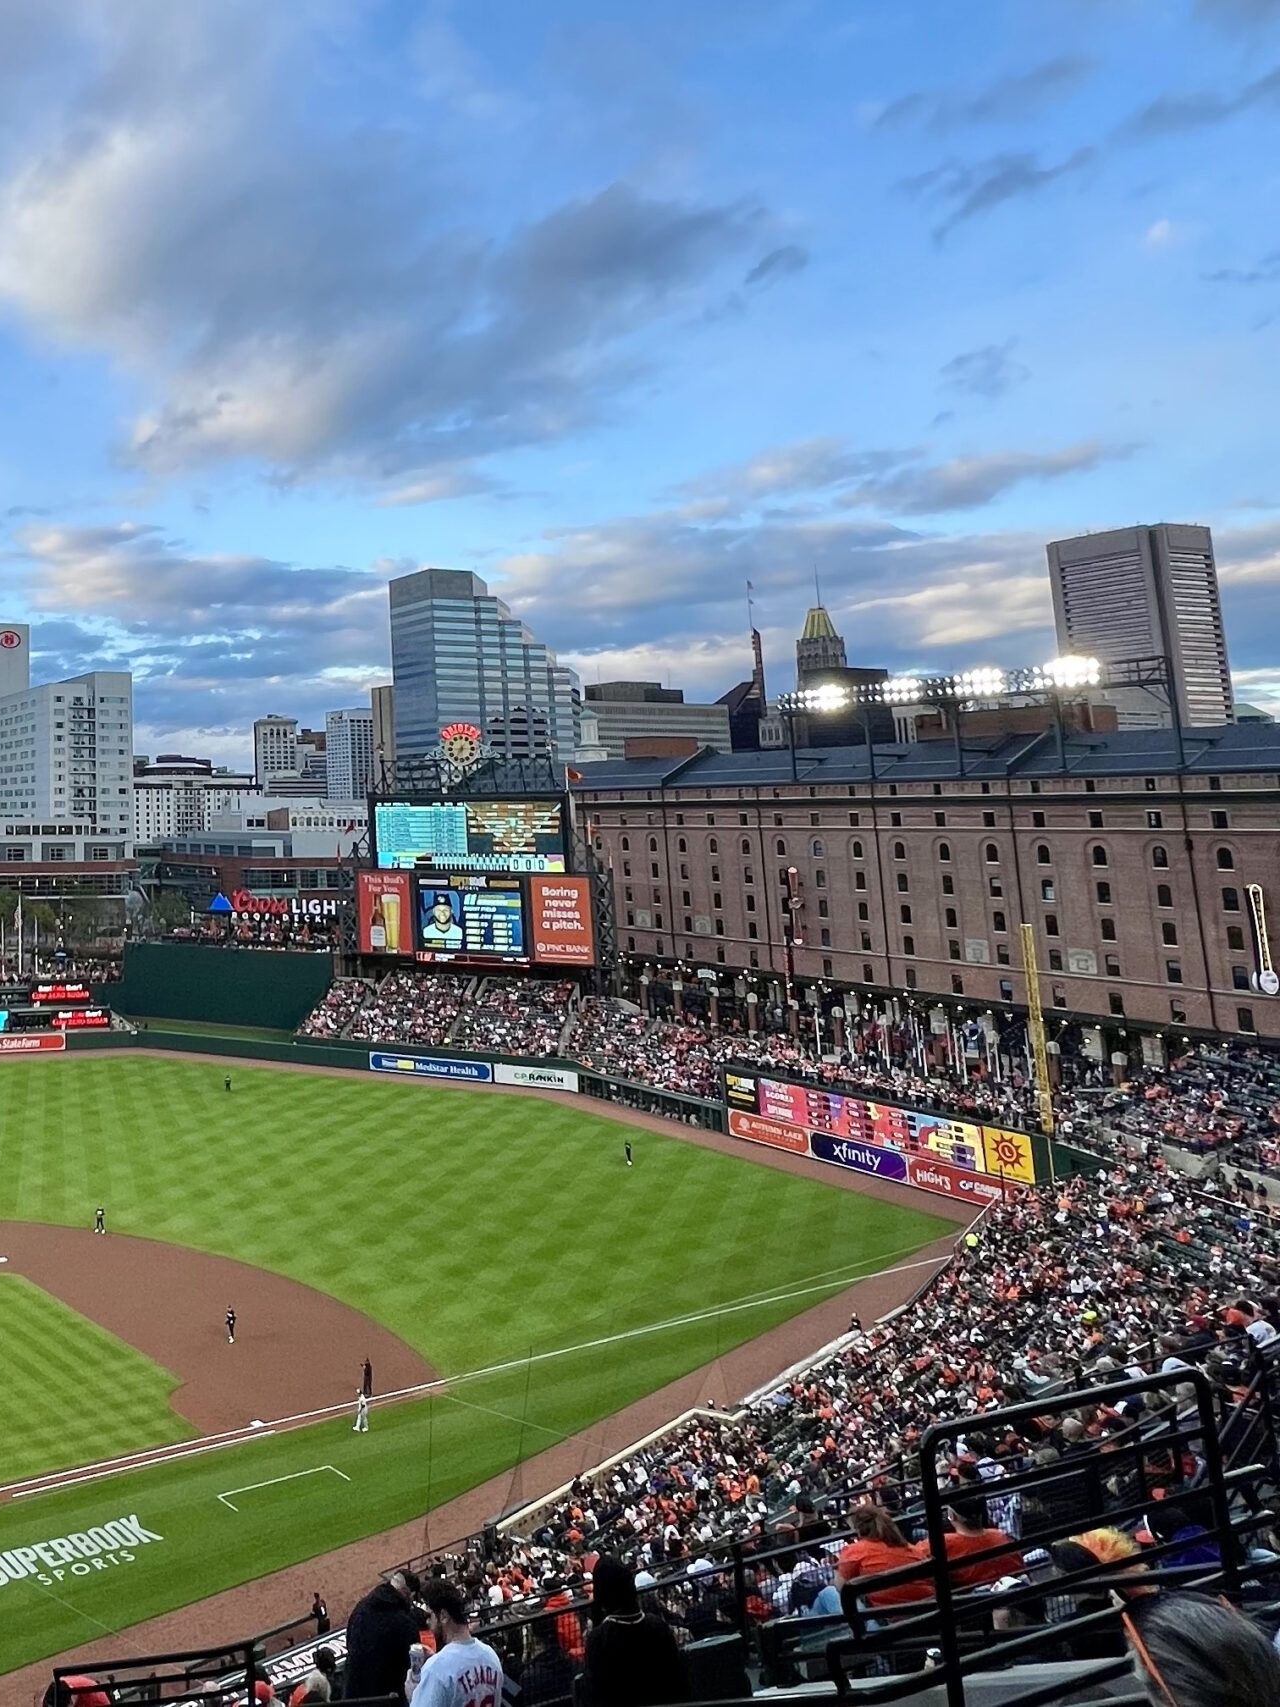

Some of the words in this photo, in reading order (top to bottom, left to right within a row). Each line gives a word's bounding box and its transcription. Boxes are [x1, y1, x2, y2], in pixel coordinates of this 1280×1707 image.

[441, 723, 481, 741] ORIOLES
[363, 875, 382, 883] This
[384, 876, 404, 884] Bud's
[383, 884, 400, 892] You.
[542, 886, 578, 898] Boring
[232, 889, 288, 912] Coors
[545, 900, 576, 908] never
[542, 908, 580, 919] misses
[552, 920, 584, 931] pitch.
[416, 1062, 449, 1073] MedStar
[450, 1066, 478, 1076] Health
[529, 1074, 564, 1083] RANKIN
[765, 1090, 794, 1103] SCORES
[751, 1122, 782, 1136] AUTUMN
[783, 1129, 804, 1142] LAKE
[833, 1142, 881, 1171] xfinity
[916, 1168, 951, 1190] HIGH'S
[37, 1550, 136, 1586] SPORTS
